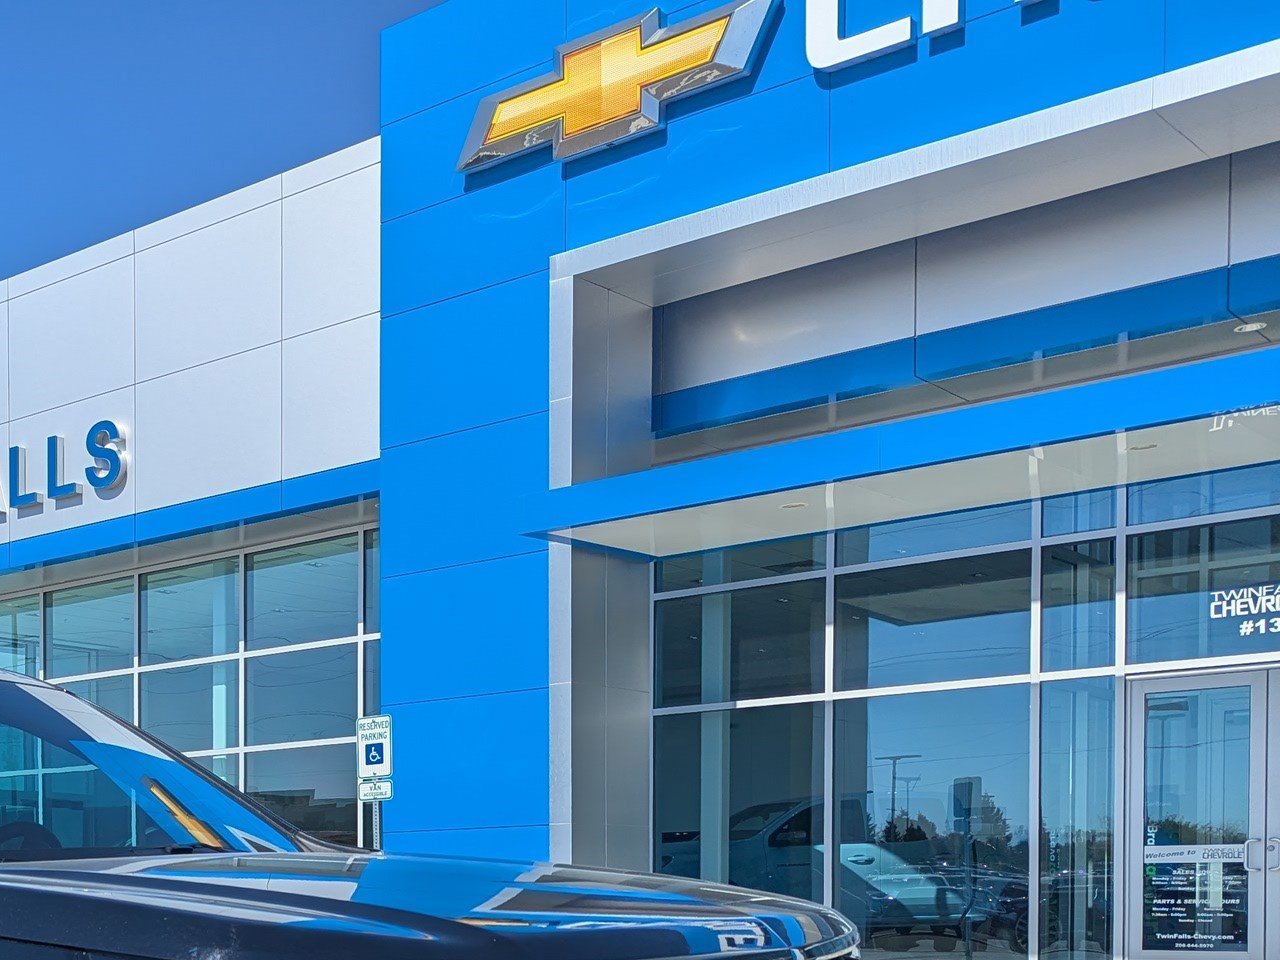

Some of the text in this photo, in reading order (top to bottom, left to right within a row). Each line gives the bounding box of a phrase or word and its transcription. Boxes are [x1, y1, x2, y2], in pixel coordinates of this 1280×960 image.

[359, 720, 389, 731] RESERVED
[361, 731, 387, 741] PARKING
[1146, 851, 1184, 859] Welcome
